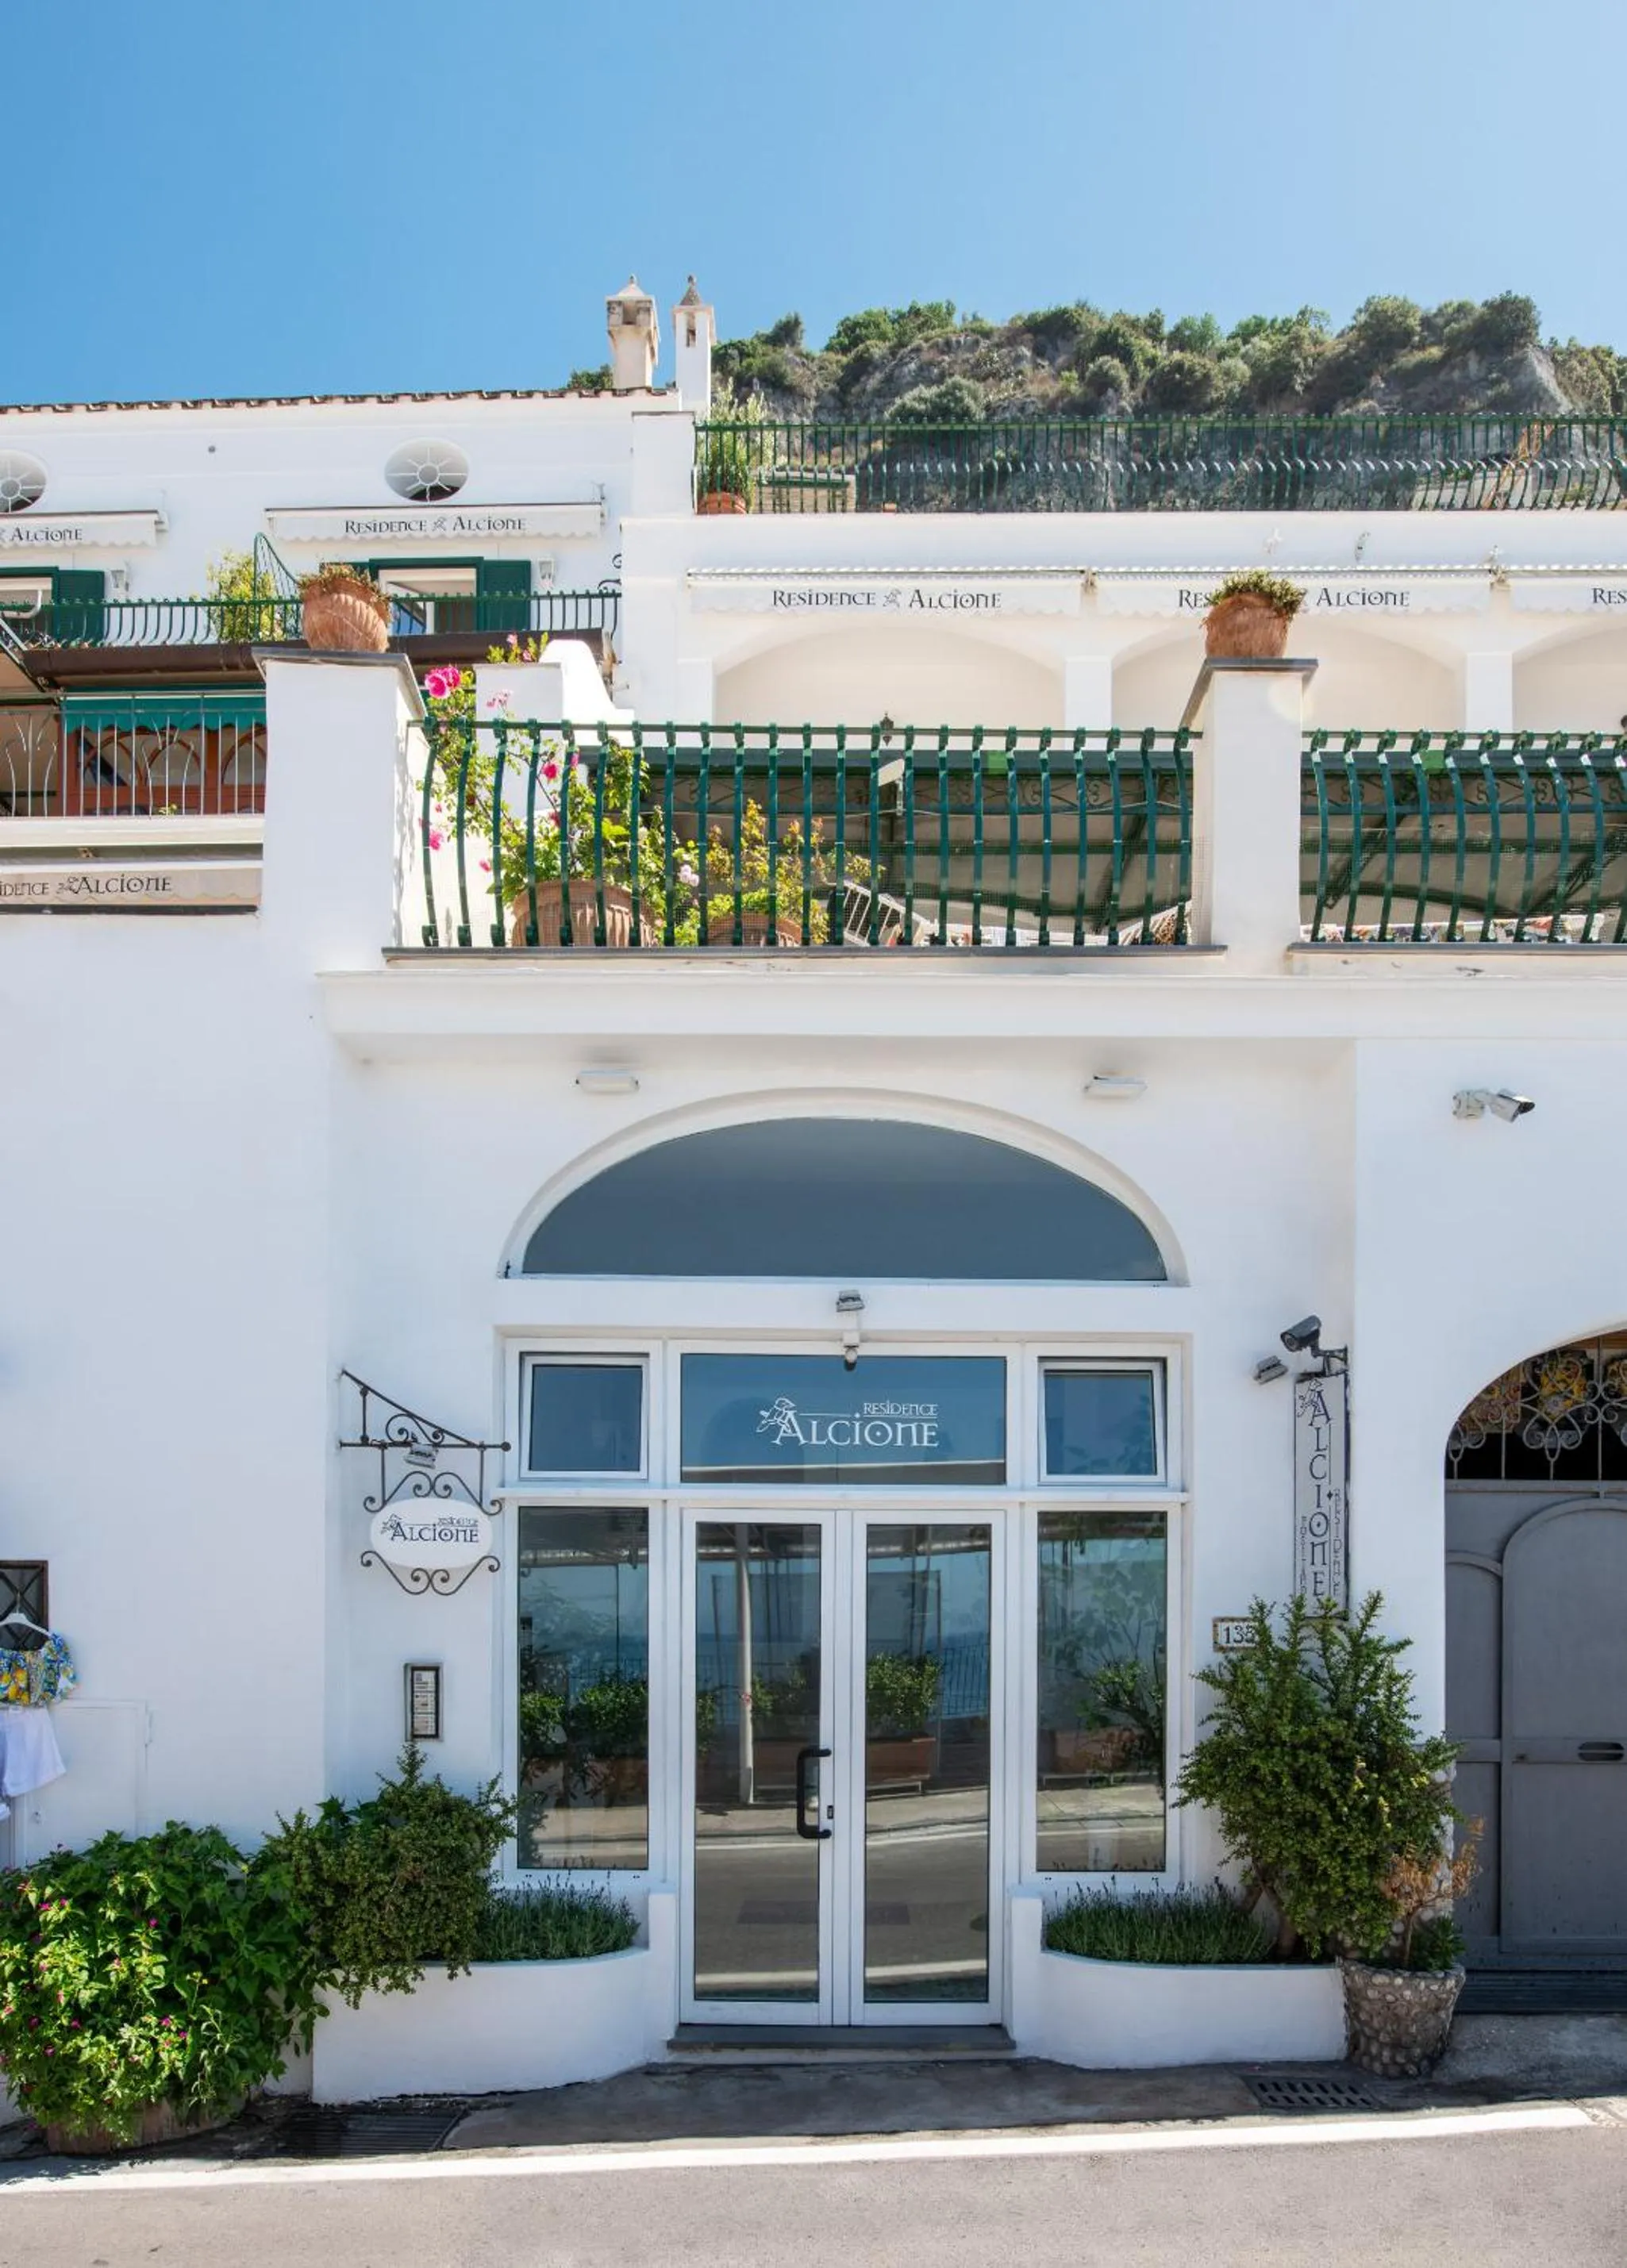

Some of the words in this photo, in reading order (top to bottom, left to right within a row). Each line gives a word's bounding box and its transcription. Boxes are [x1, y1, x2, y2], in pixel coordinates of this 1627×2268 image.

[344, 518, 427, 534] RESIDENCE
[452, 516, 526, 531] ALCIONE
[772, 589, 876, 608] RESIDENCE
[909, 589, 1002, 609] ALCIONE
[1316, 587, 1410, 607] ALCIONE
[79, 874, 172, 894] ALCIONE
[863, 1400, 938, 1416] RESIDENCE
[771, 1410, 940, 1447] ALCIONE
[390, 1522, 479, 1543] ALCIONE
